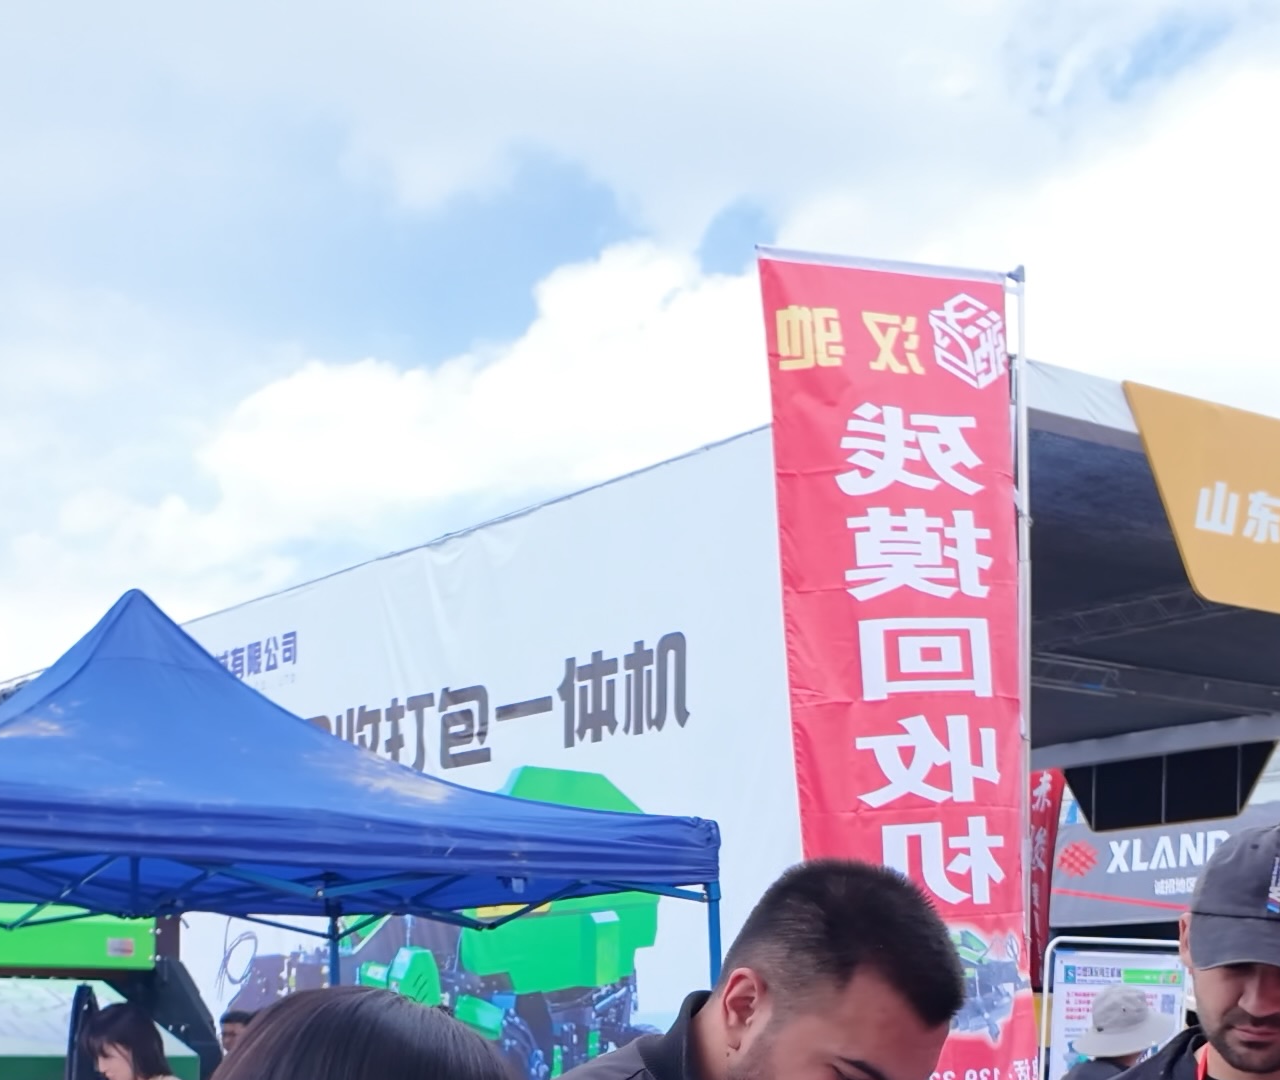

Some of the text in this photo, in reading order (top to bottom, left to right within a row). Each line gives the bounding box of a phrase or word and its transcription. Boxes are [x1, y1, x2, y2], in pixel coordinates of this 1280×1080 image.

[305, 631, 691, 772] 收打包一体机
